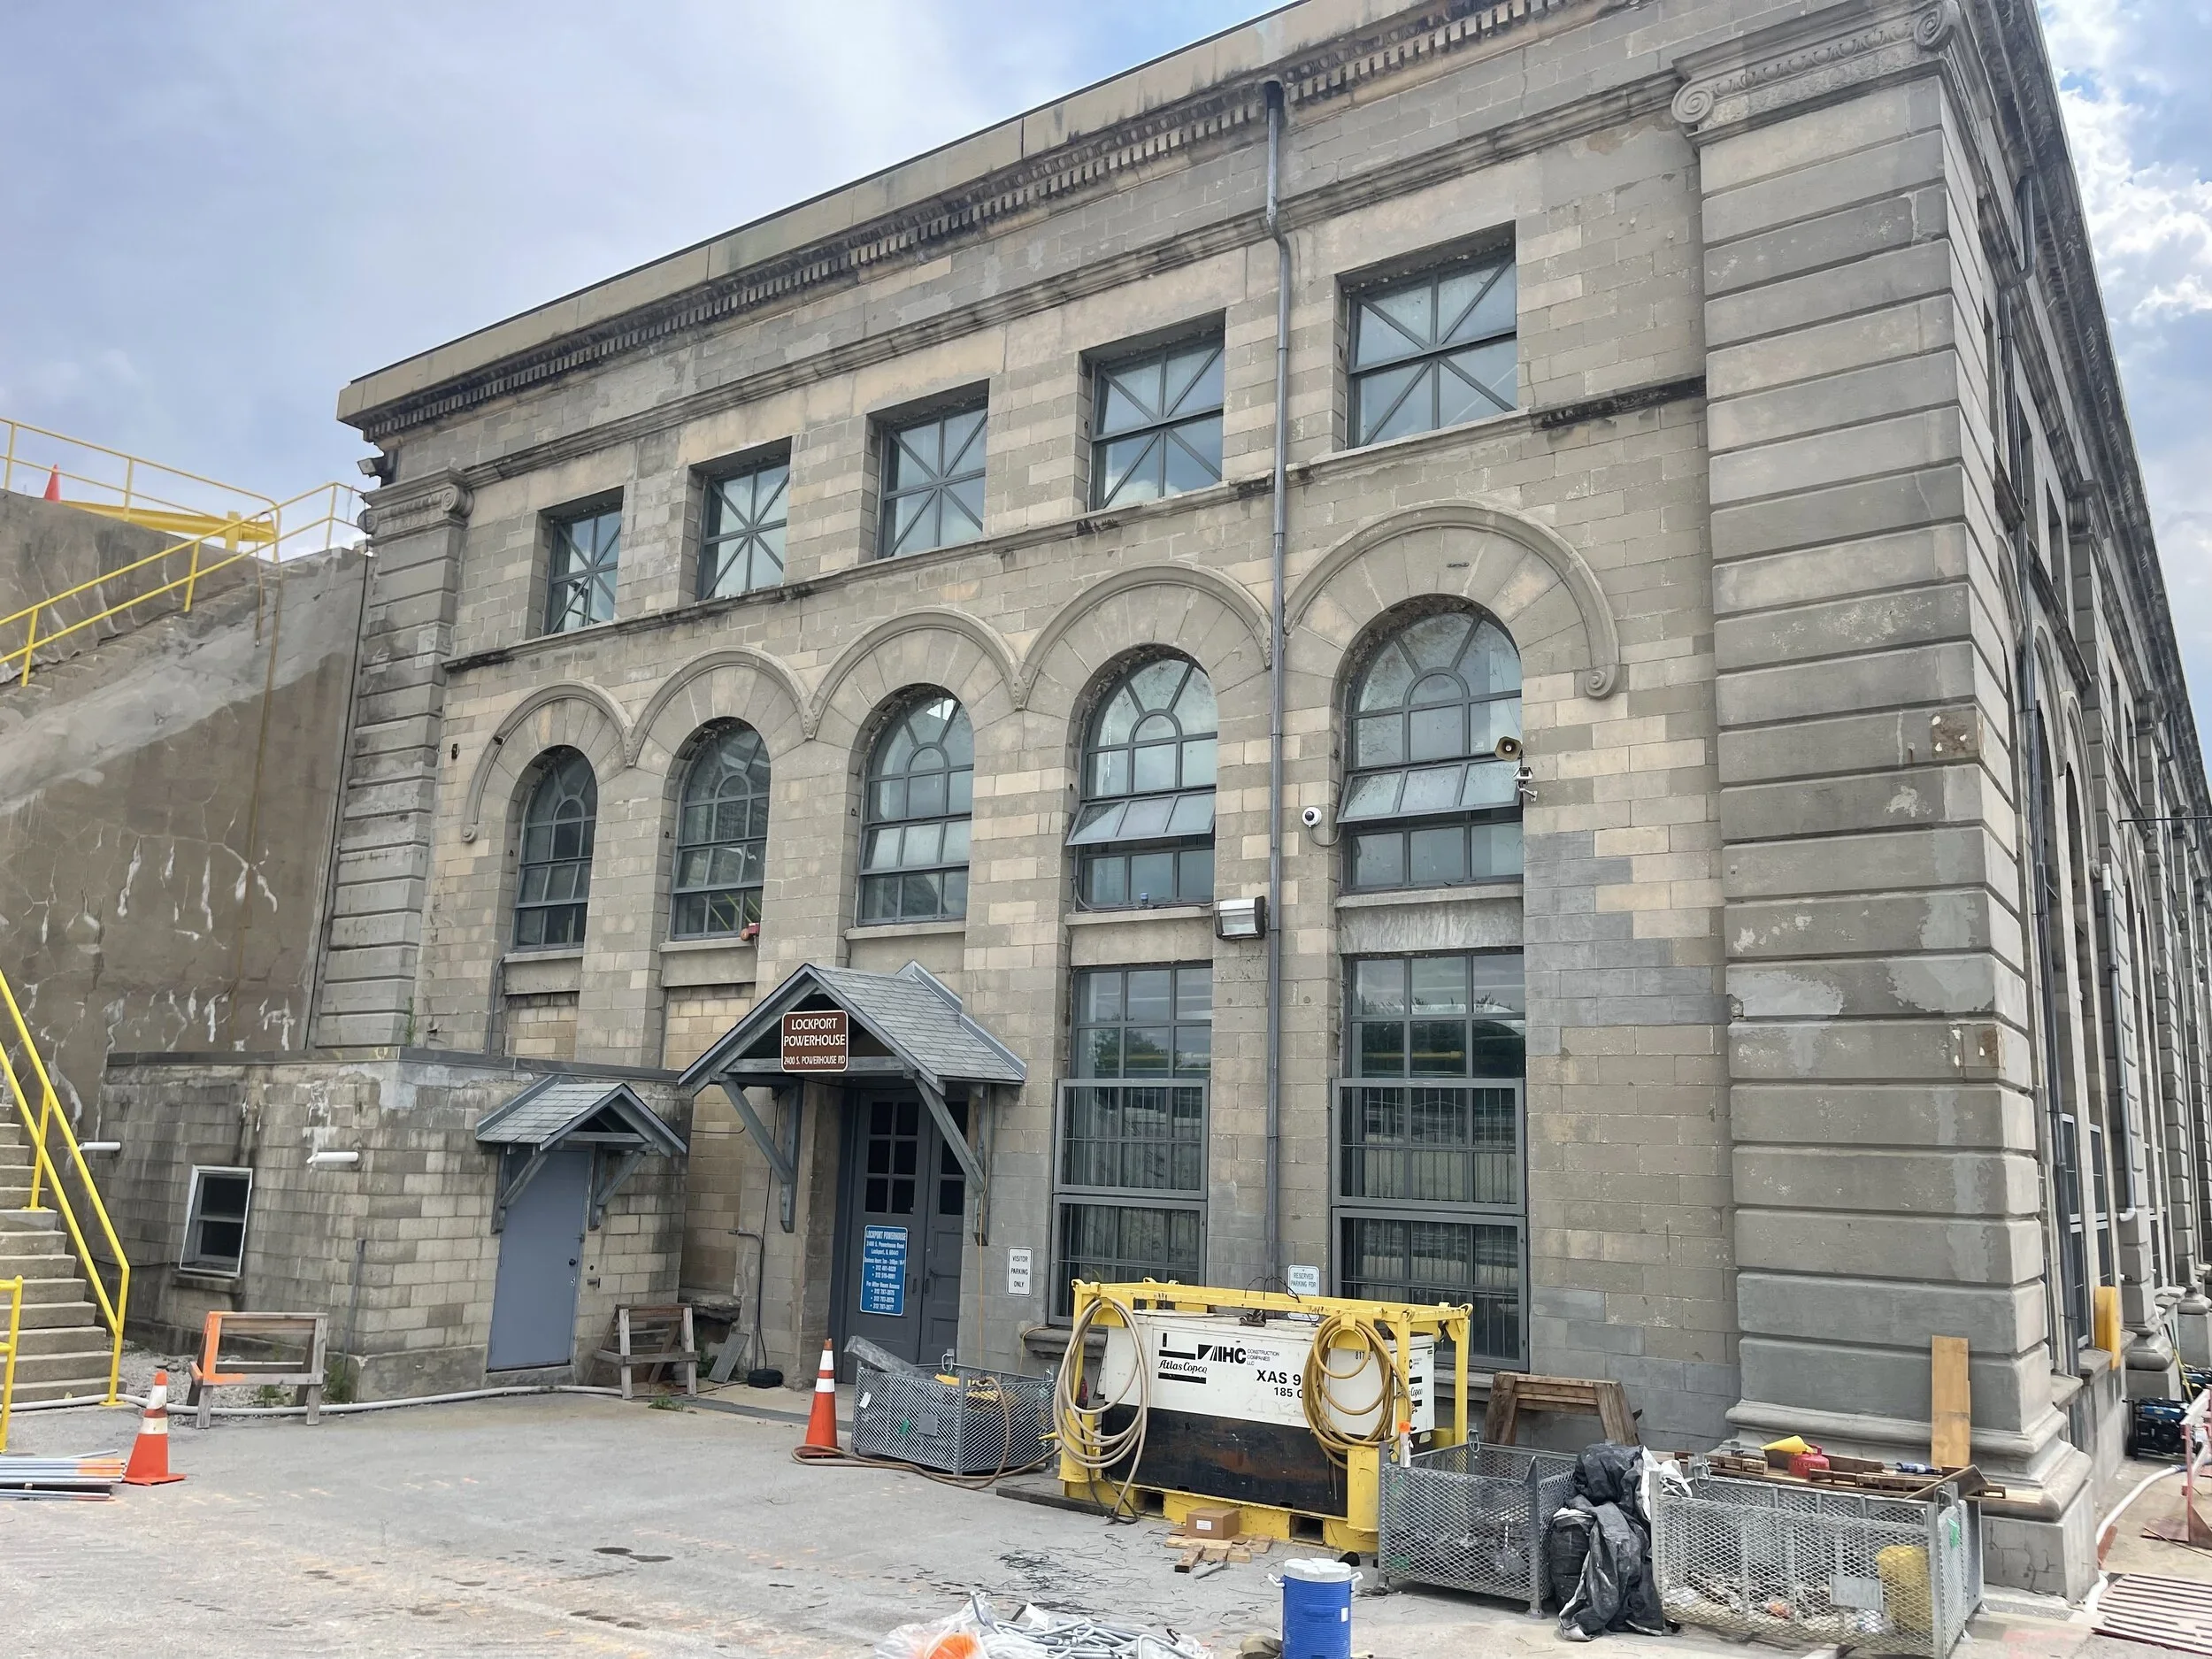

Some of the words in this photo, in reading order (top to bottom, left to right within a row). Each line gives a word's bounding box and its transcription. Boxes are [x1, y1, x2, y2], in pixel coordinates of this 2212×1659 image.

[791, 1018, 838, 1030] LOCKPORT
[784, 1034, 846, 1047] POWERHOUSE
[784, 1056, 795, 1065] 2400
[801, 1056, 837, 1064] POWERHOUSE
[866, 1230, 883, 1239] LOCKPORT
[1010, 1267, 1028, 1276] PARKING
[1247, 1348, 1280, 1356] CONSTRUCTION
[1158, 1359, 1183, 1371] Atlas
[1183, 1362, 1208, 1374] Copco
[1256, 1369, 1287, 1385] XAS
[1274, 1386, 1294, 1398] 185
